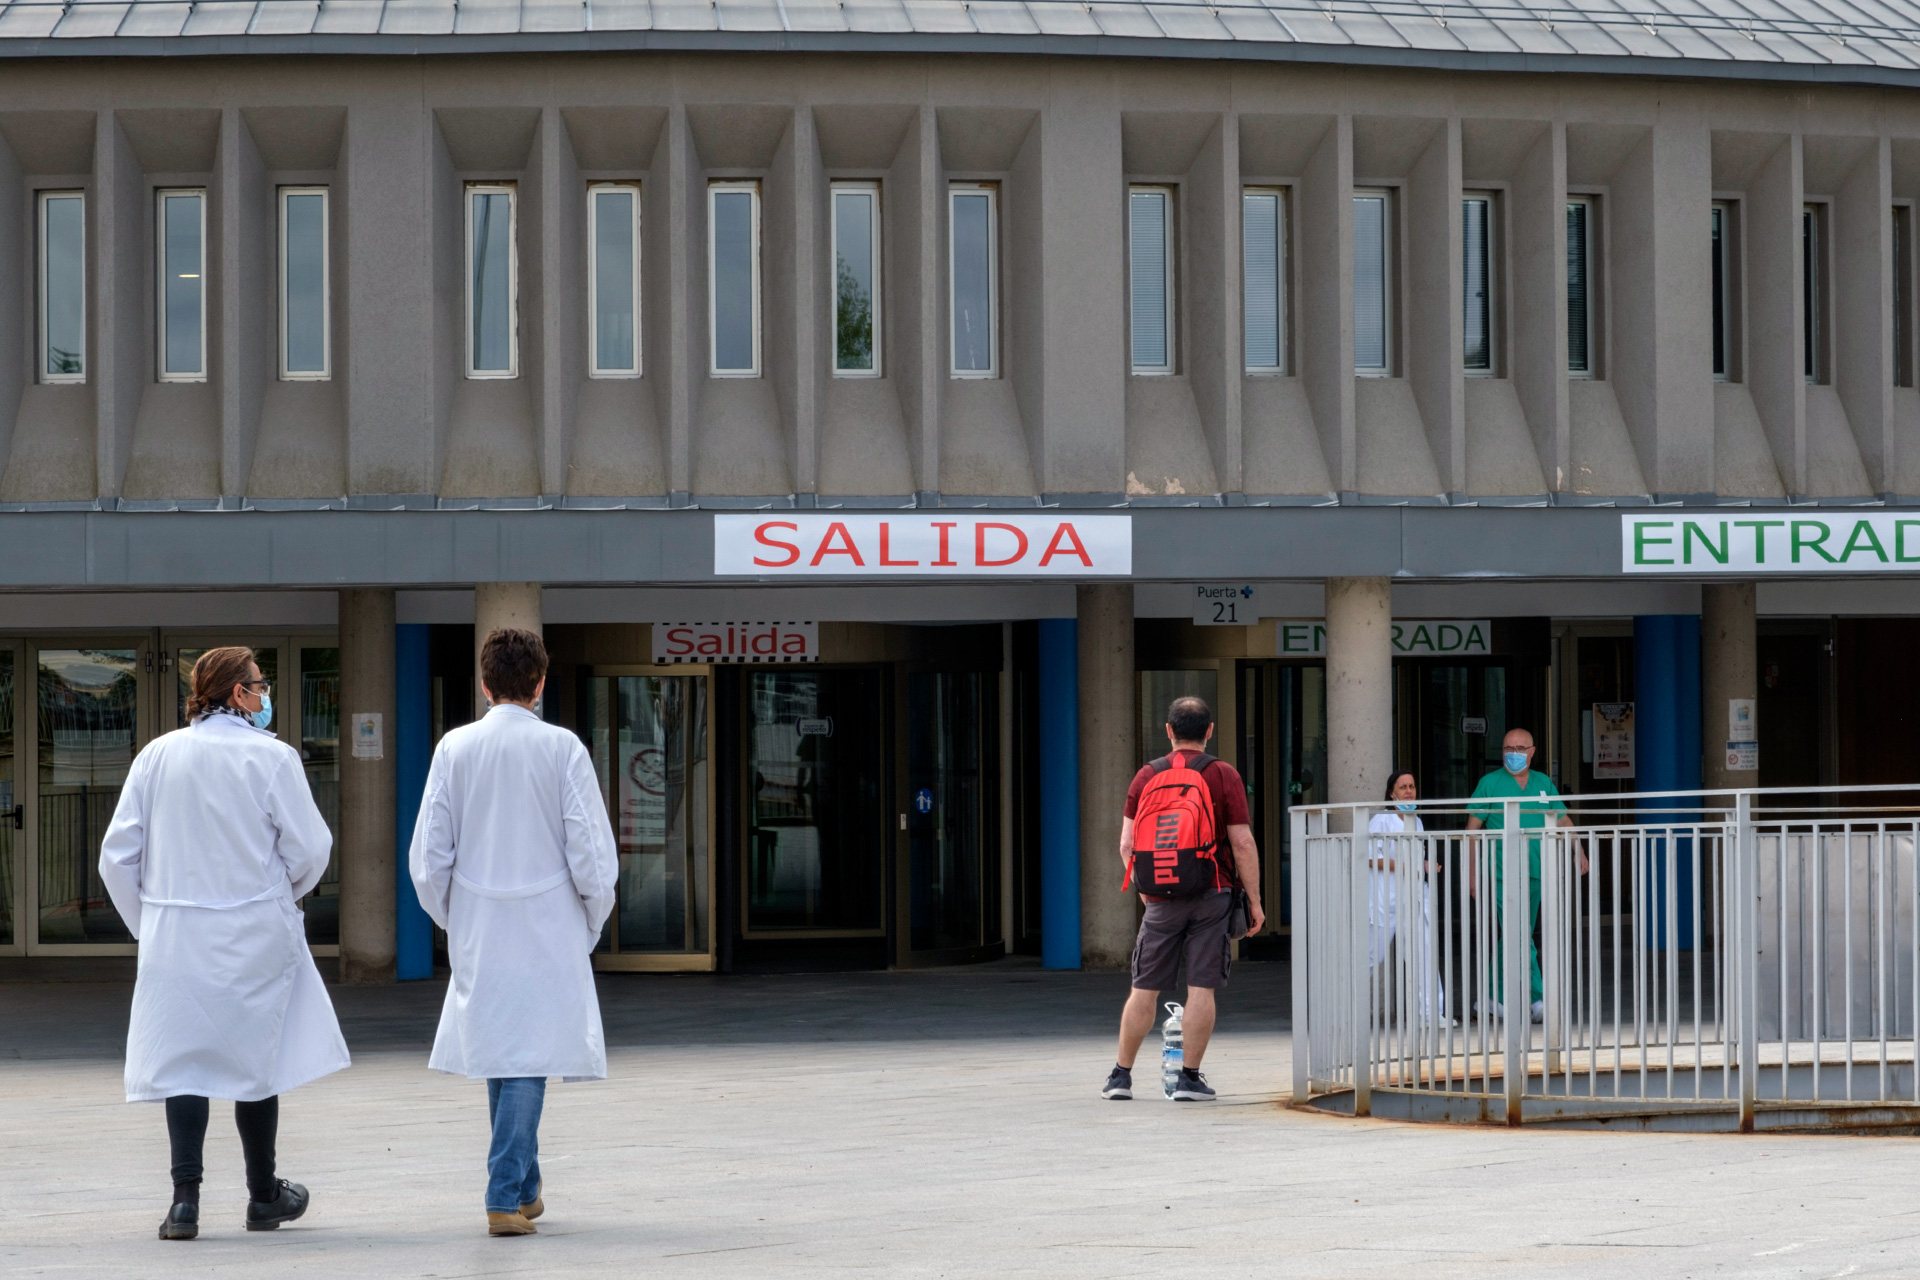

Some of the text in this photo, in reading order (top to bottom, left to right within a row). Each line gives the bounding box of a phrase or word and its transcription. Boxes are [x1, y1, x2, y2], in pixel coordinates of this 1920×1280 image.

[752, 520, 1094, 567] SALIDA
[1198, 586, 1237, 598] Puerta
[1213, 602, 1238, 622] 21
[666, 627, 806, 655] Salida
[1282, 624, 1487, 652] ENRADA
[1153, 813, 1180, 885] PUMA
